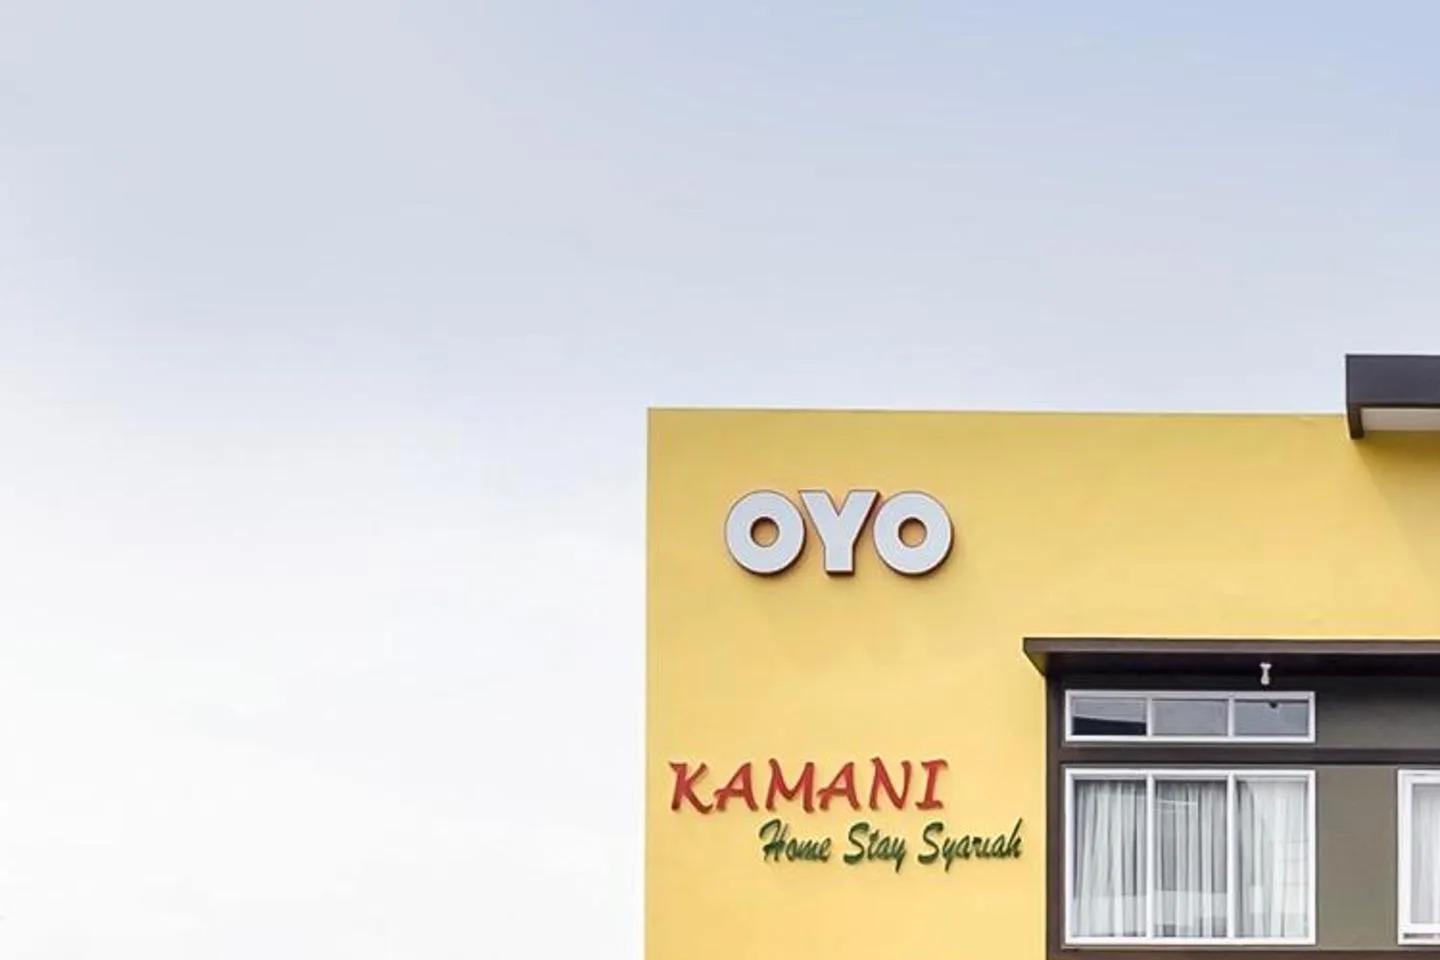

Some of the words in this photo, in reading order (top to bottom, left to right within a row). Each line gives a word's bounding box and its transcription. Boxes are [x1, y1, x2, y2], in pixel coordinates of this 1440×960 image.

[725, 489, 954, 576] OYO
[669, 757, 949, 814] KAMANI
[759, 819, 832, 863] Home
[843, 822, 906, 873] Stay
[918, 818, 1022, 872] Syariah
